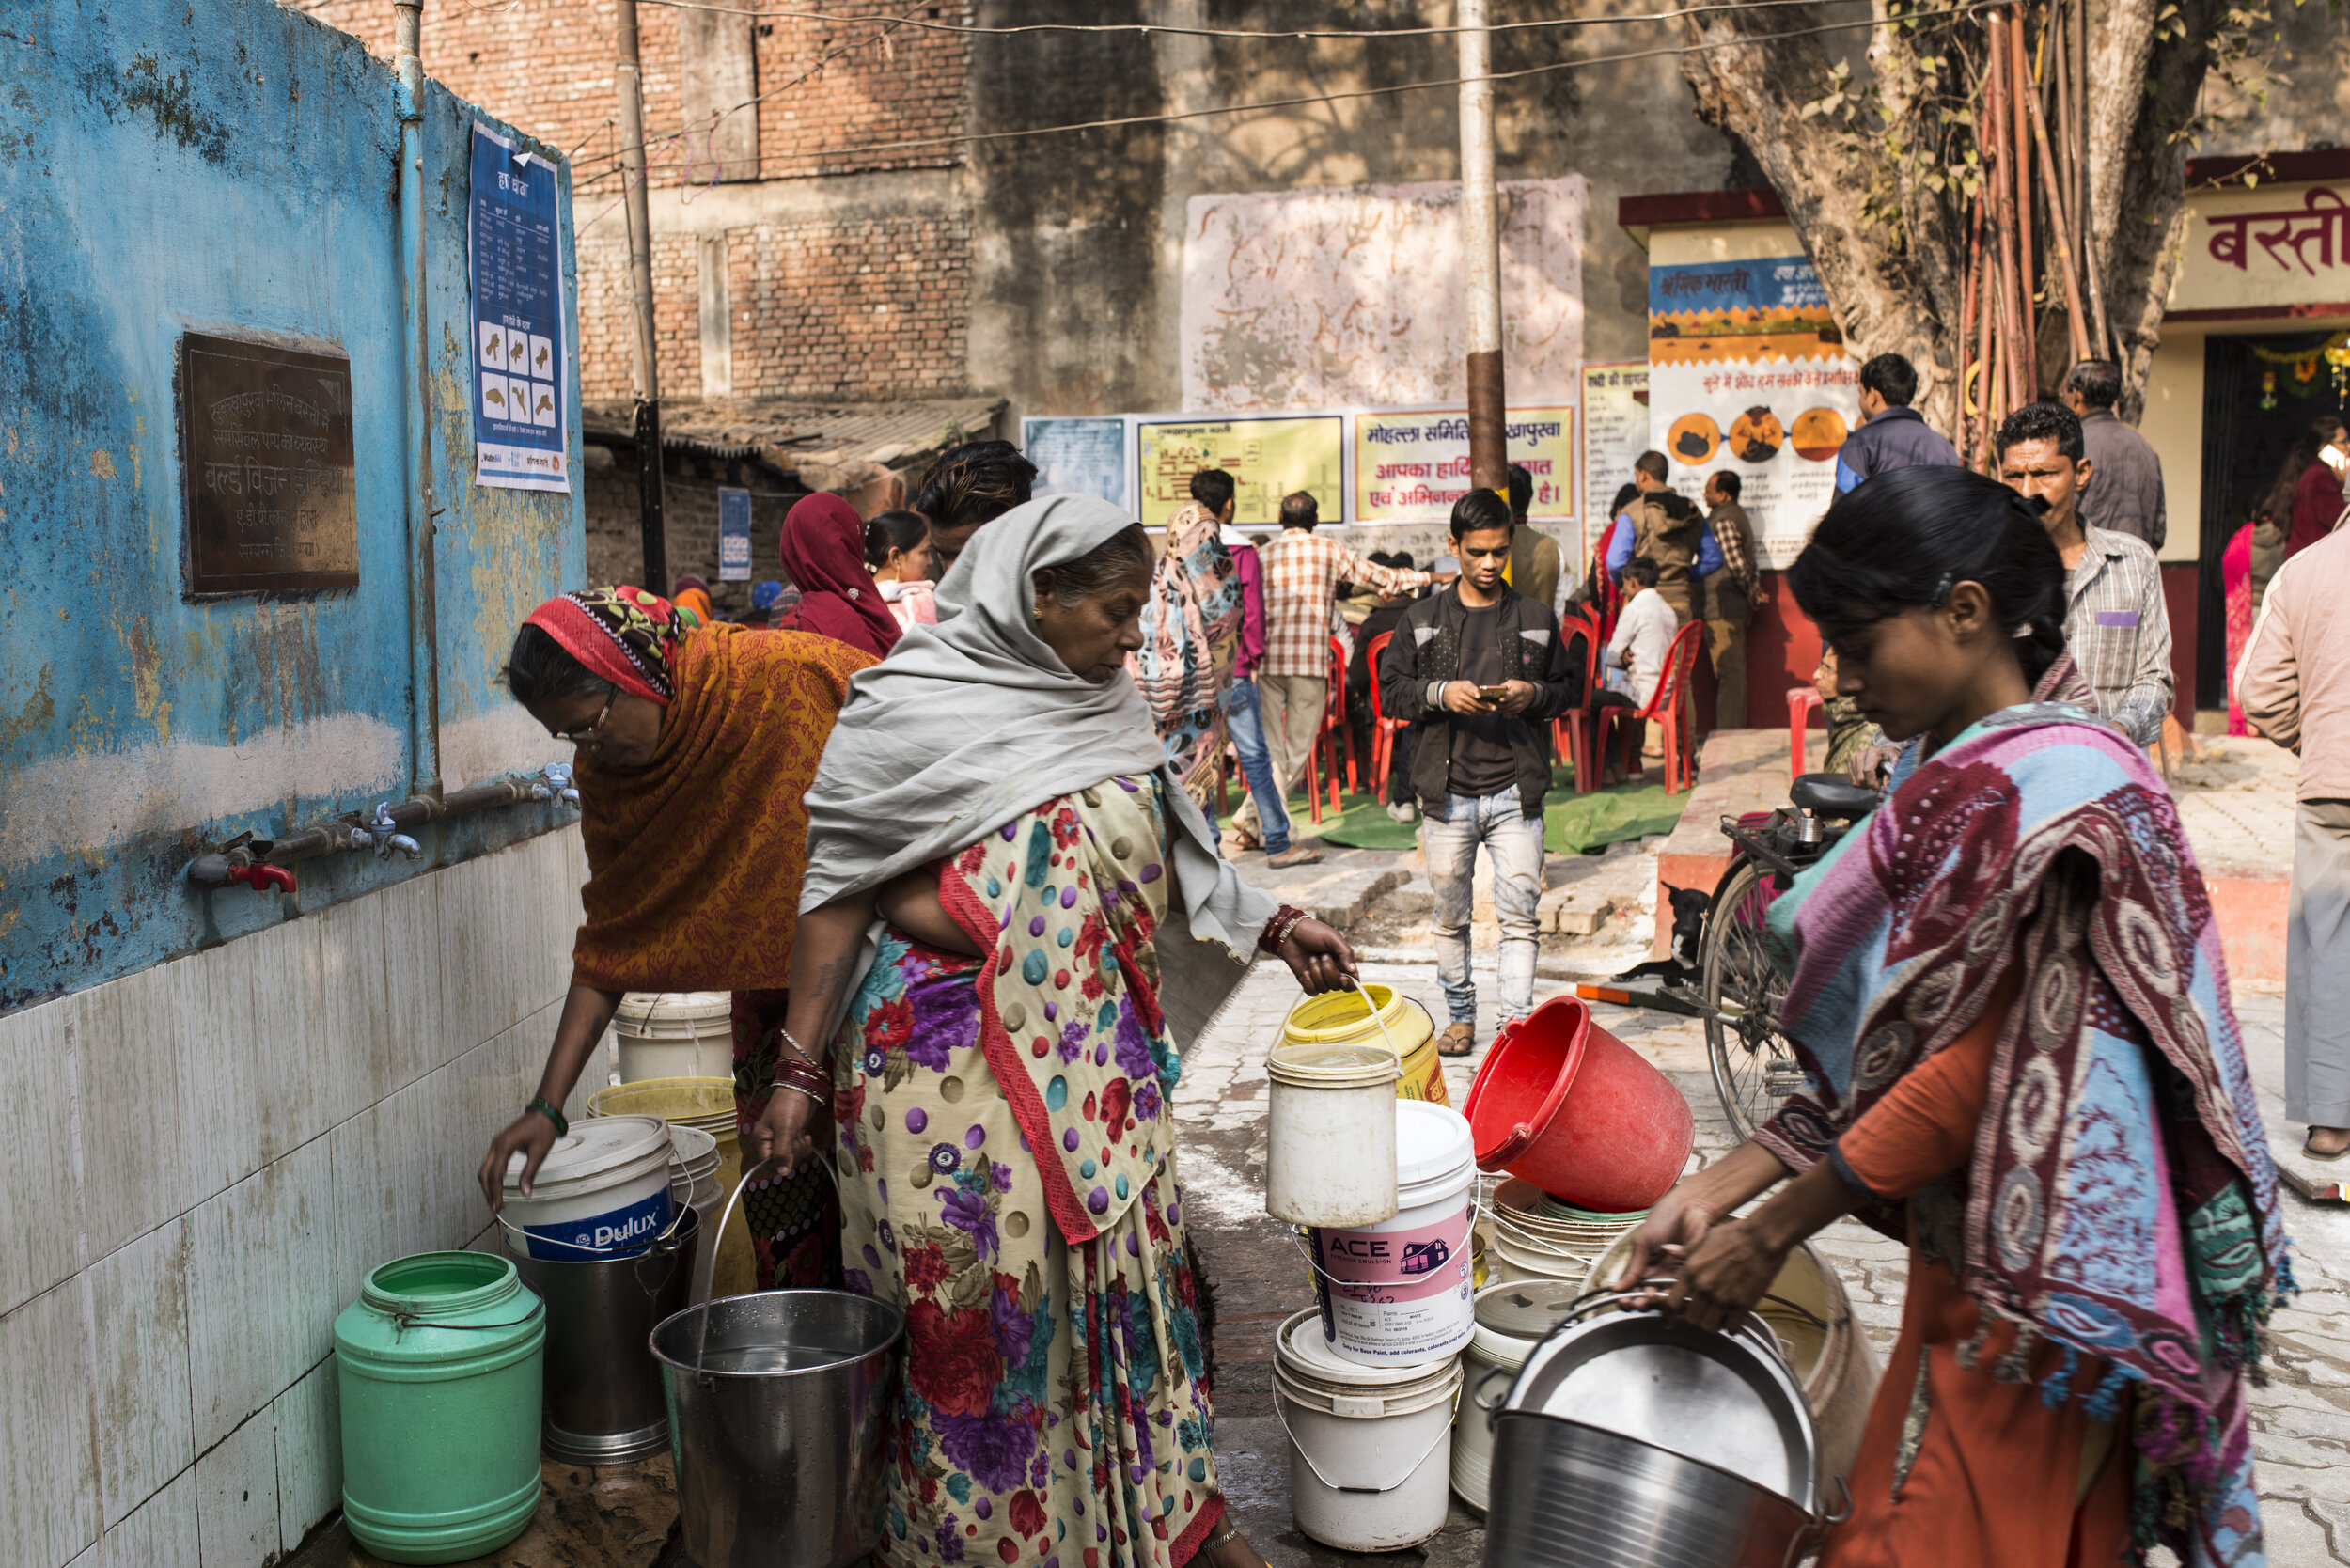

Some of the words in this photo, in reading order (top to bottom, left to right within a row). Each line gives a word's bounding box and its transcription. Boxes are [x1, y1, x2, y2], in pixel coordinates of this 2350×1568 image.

[2206, 186, 2350, 277] बस्ती
[1367, 423, 1420, 444] मोहल्ला
[1425, 419, 1470, 440] समिति
[1506, 422, 1560, 447] खापुरवा
[1375, 462, 1431, 479] आपका
[1436, 455, 1470, 479] हार्दि
[1369, 486, 1395, 507] एवं
[595, 1211, 657, 1247] Dulux
[1330, 1236, 1390, 1257] ACE
[1330, 1253, 1356, 1264] EXTERIOR
[1342, 1342, 1352, 1352] Only
[1401, 1346, 1426, 1356] colorants,
[1427, 1340, 1449, 1351] colorants
[1449, 1335, 1458, 1343] cost
